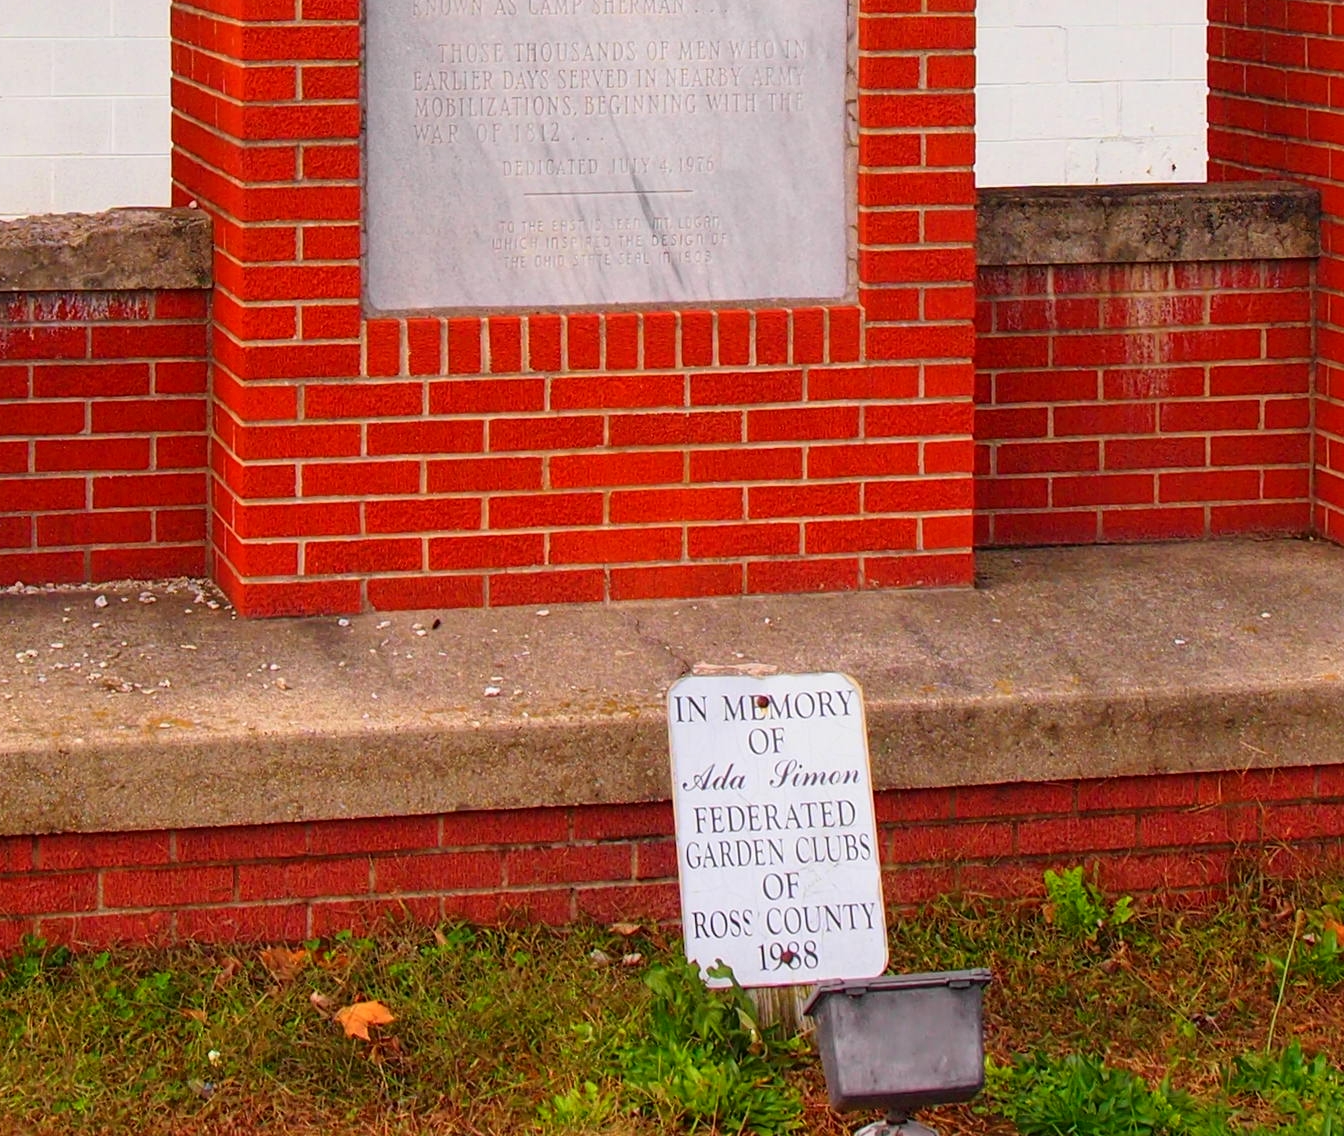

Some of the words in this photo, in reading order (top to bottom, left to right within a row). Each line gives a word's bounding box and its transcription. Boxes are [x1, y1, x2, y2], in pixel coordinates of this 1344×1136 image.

[438, 42, 504, 63] THOSE
[514, 41, 636, 62] THOUSANDS
[647, 41, 669, 61] OF
[677, 41, 721, 61] MEN
[728, 40, 774, 60] WHO
[784, 40, 806, 59] IN
[413, 70, 493, 91] EARLIER
[503, 70, 549, 90] DAYS
[557, 69, 628, 89] SERVED
[637, 69, 656, 88] IN
[666, 68, 742, 88] NEARBY
[752, 67, 806, 87] ARMY
[584, 94, 696, 115] BEGINNING
[706, 93, 756, 113] WITH
[768, 93, 804, 113] THE
[413, 124, 458, 145] WAR
[476, 124, 502, 144] OF
[514, 122, 561, 144] 1812
[503, 159, 598, 177] DEDICATED
[610, 158, 649, 176] JULY
[674, 695, 707, 723] IN
[721, 689, 856, 721] MEMORY
[748, 727, 785, 755] OF
[682, 763, 746, 792] Ada
[769, 759, 861, 789] Simon
[693, 799, 856, 834] FEDERATED
[686, 838, 785, 870] GARDEN
[795, 833, 871, 865] CLUBS
[762, 872, 800, 901] OF
[691, 909, 753, 939] ROSS
[766, 902, 875, 935] COUNTY
[758, 939, 819, 971] 1988
